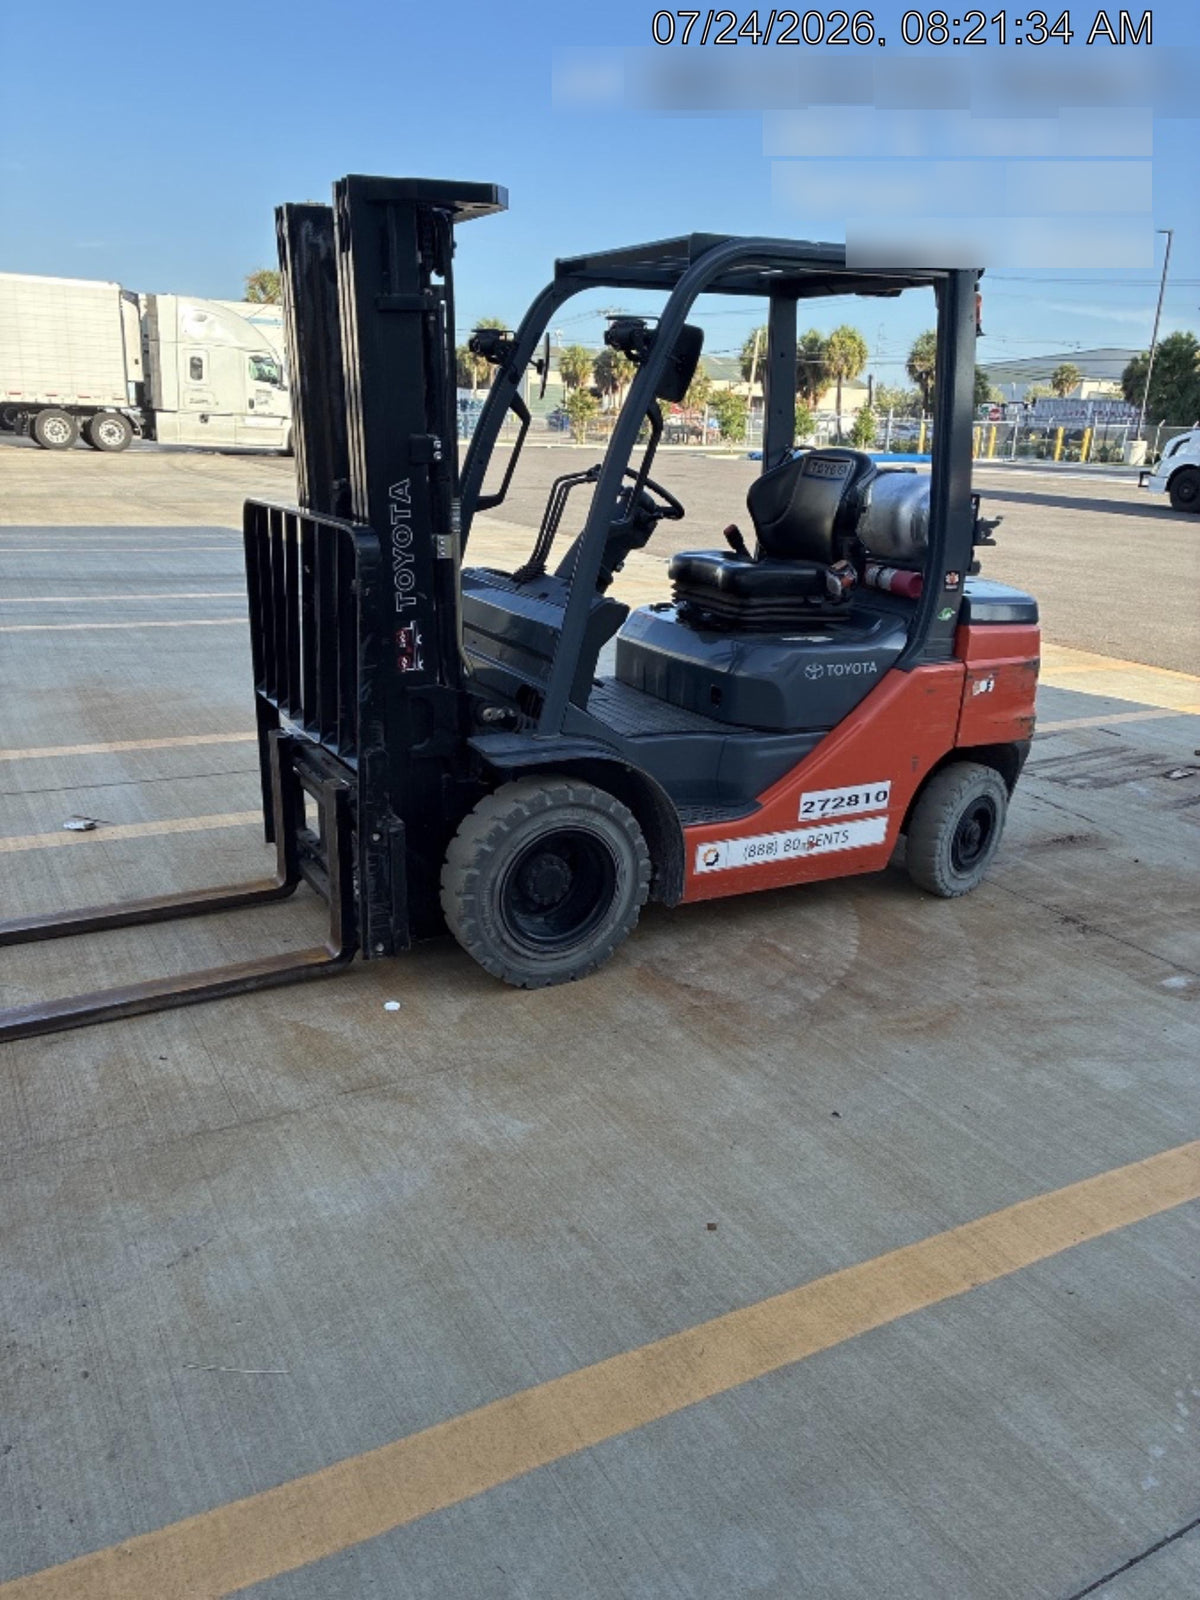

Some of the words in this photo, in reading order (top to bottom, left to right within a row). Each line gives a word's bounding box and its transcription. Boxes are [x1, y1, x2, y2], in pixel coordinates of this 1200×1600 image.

[388, 478, 417, 612] TOYOTA
[826, 661, 878, 676] TOYOTA
[802, 790, 888, 813] 272810
[743, 838, 778, 860] (888)
